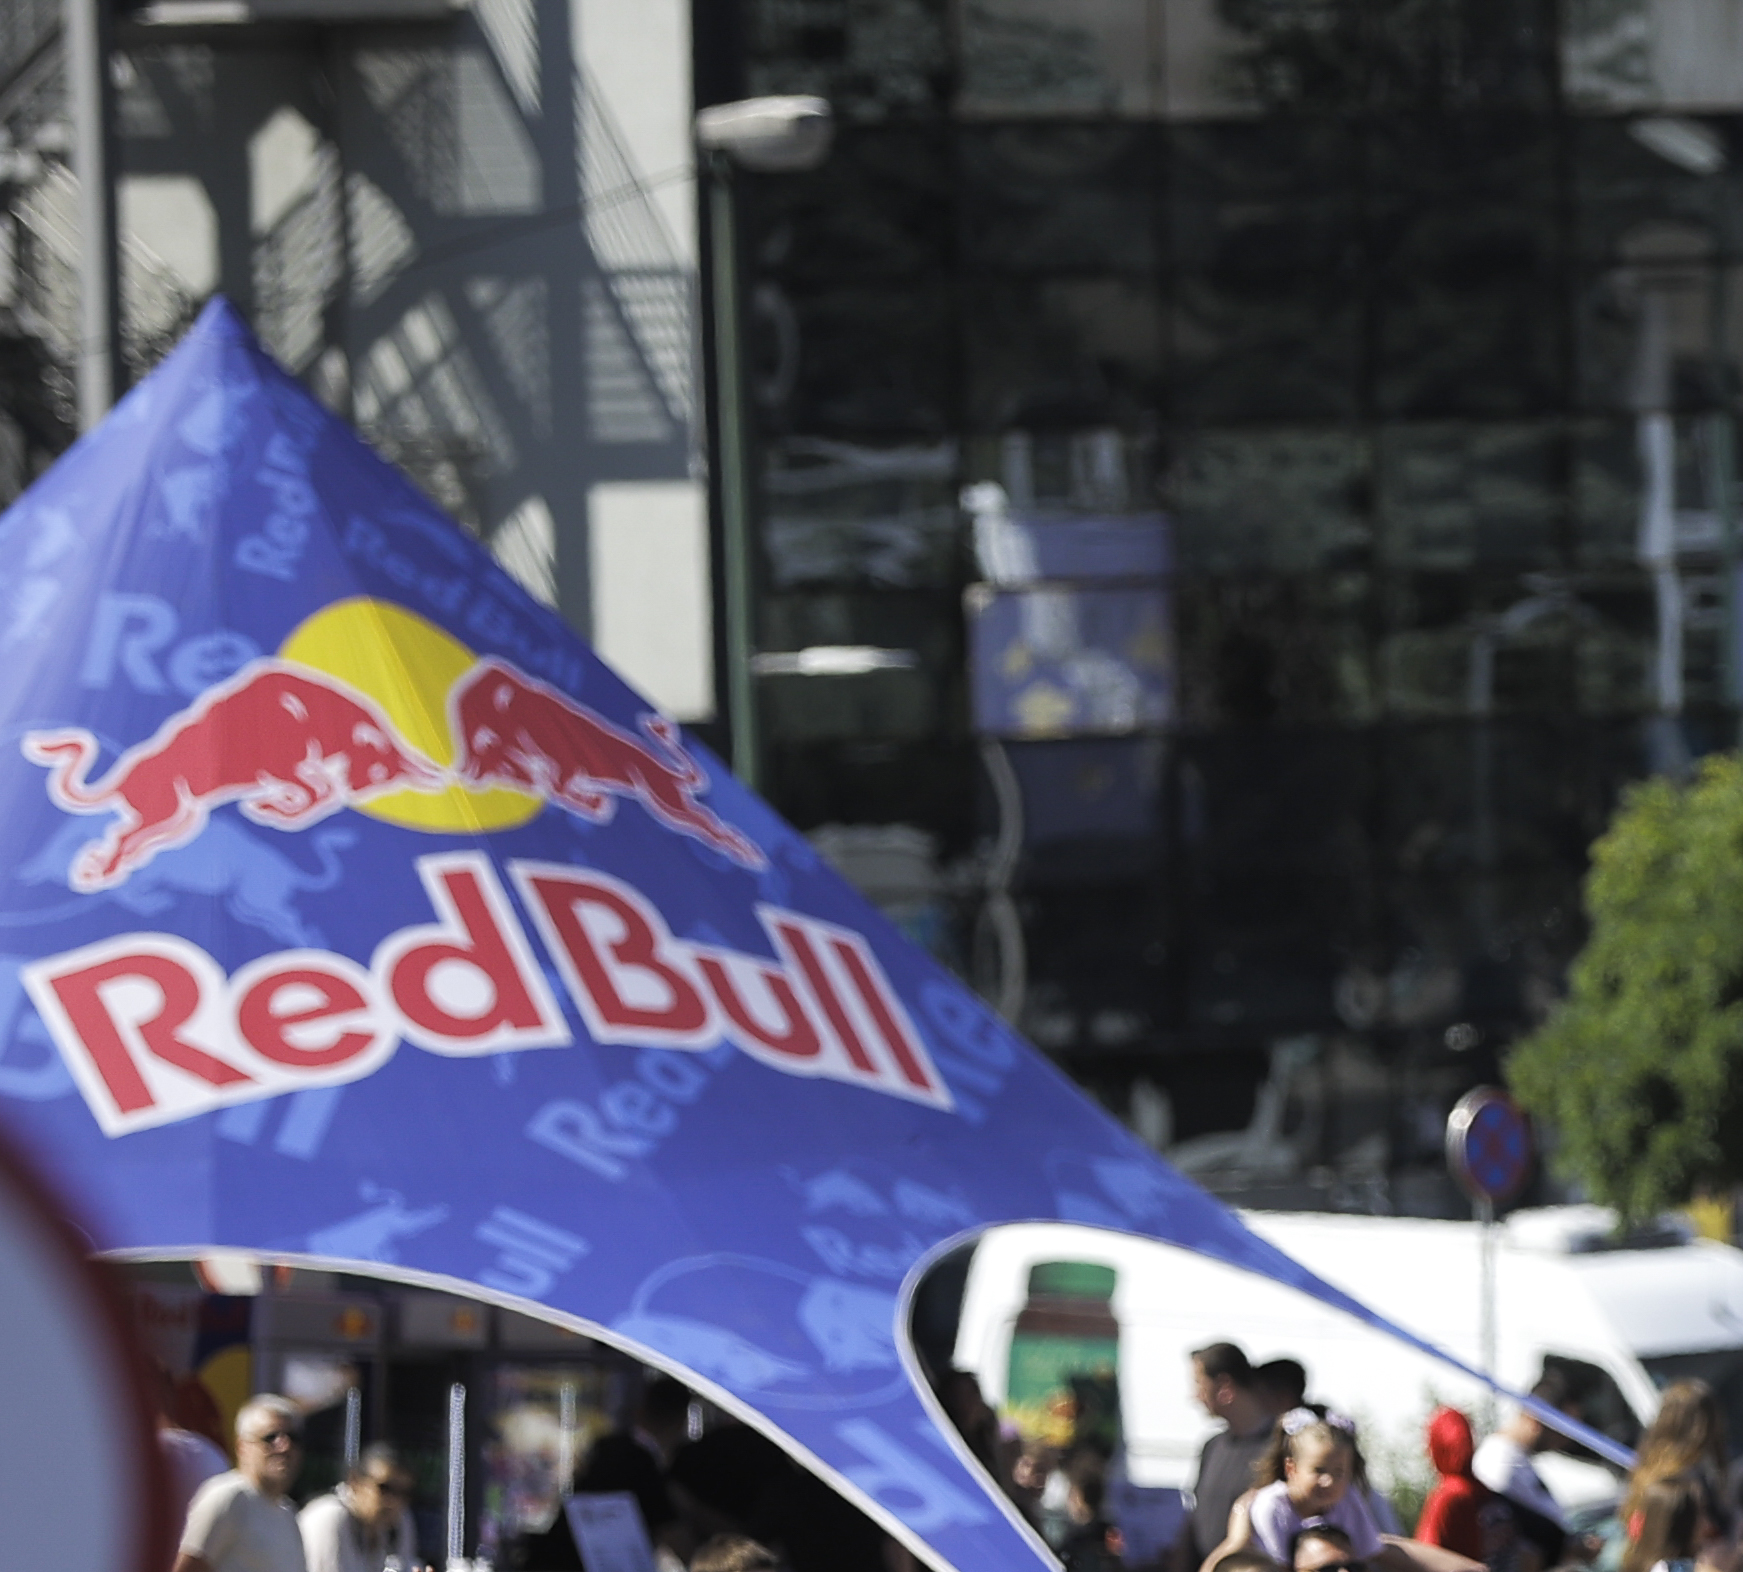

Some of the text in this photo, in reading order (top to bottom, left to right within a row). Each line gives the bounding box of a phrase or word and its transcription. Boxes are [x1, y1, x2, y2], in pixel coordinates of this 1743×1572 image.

[80, 588, 266, 694] Re
[33, 860, 558, 1126] Red
[518, 866, 946, 1104] Bull
